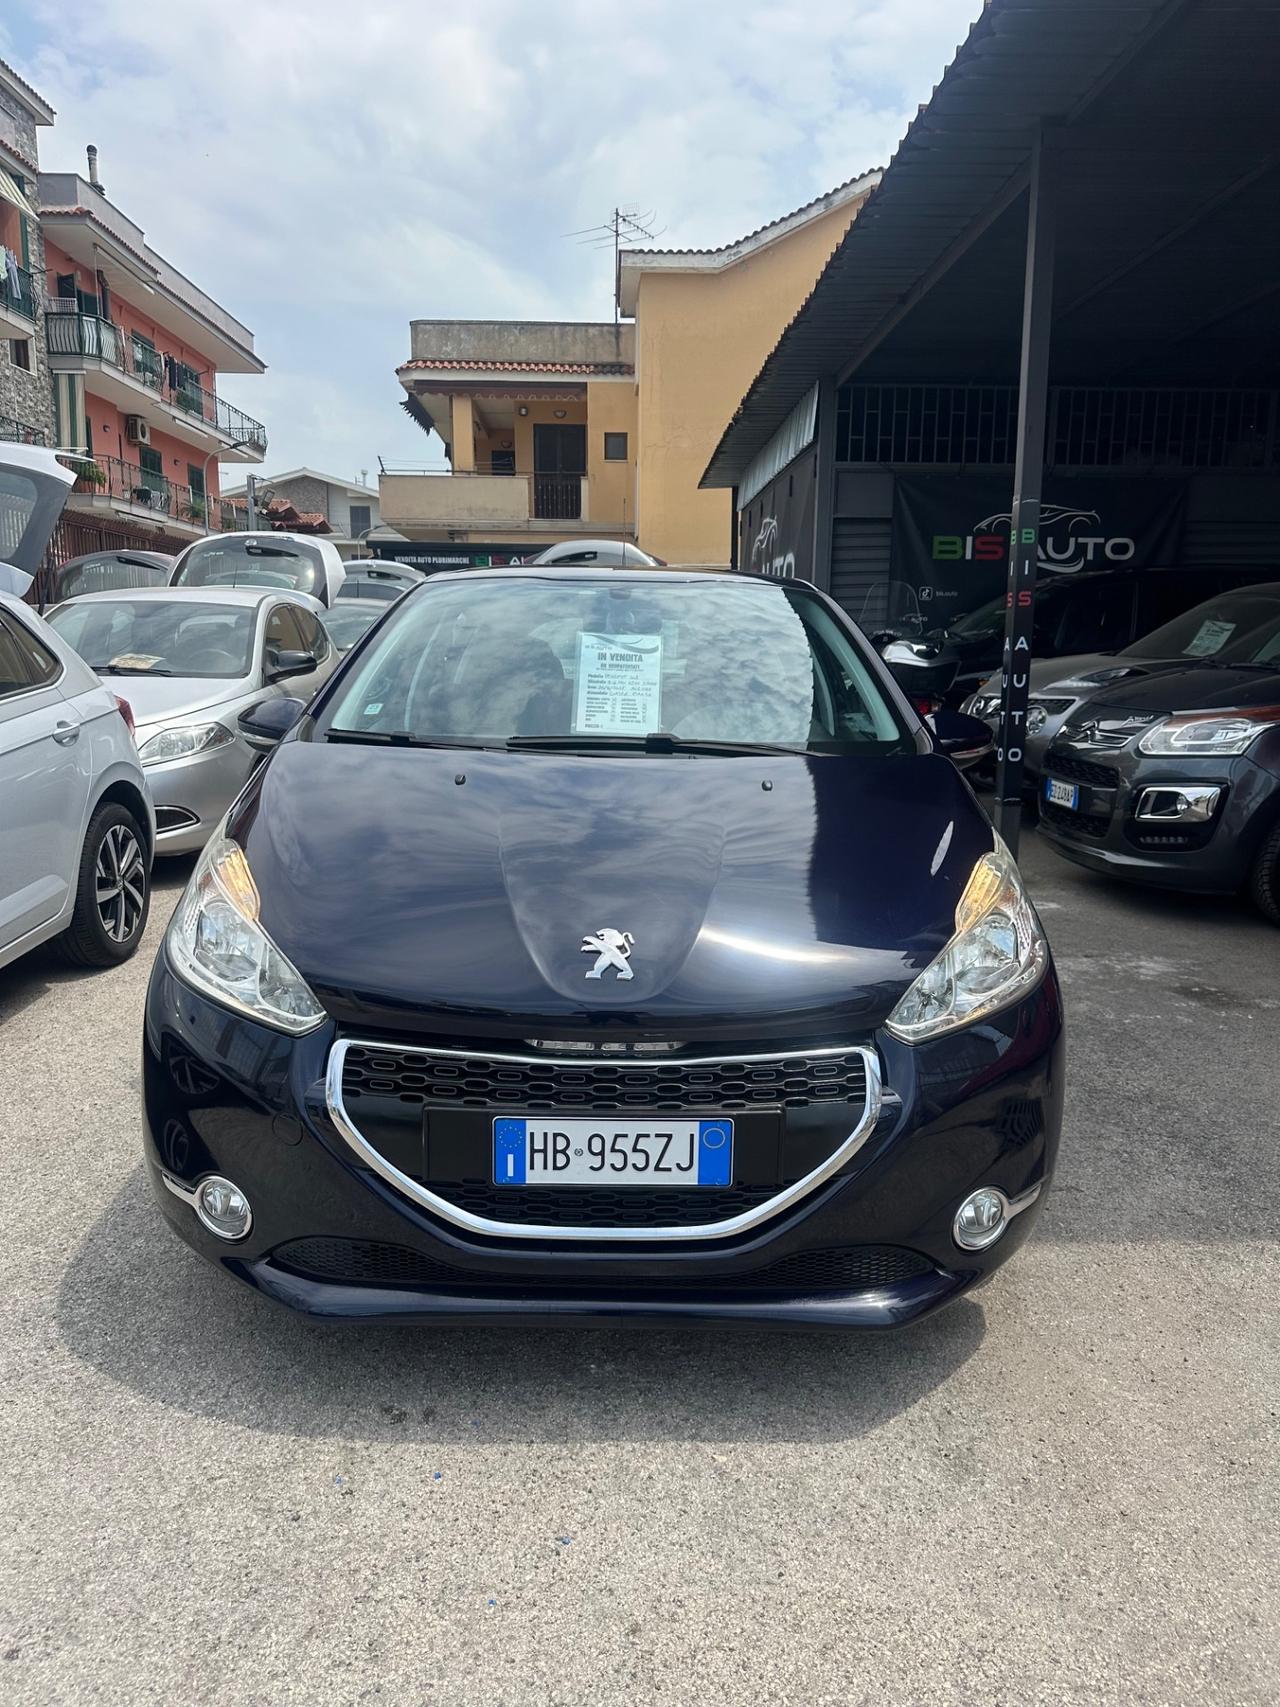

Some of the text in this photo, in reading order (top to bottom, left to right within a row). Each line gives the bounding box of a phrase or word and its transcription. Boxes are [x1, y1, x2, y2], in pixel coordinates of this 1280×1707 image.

[933, 536, 1005, 560] BIS
[394, 555, 417, 563] VENDITA
[597, 652, 643, 662] IN VENDITA
[529, 1131, 695, 1172] HB 955ZJ
